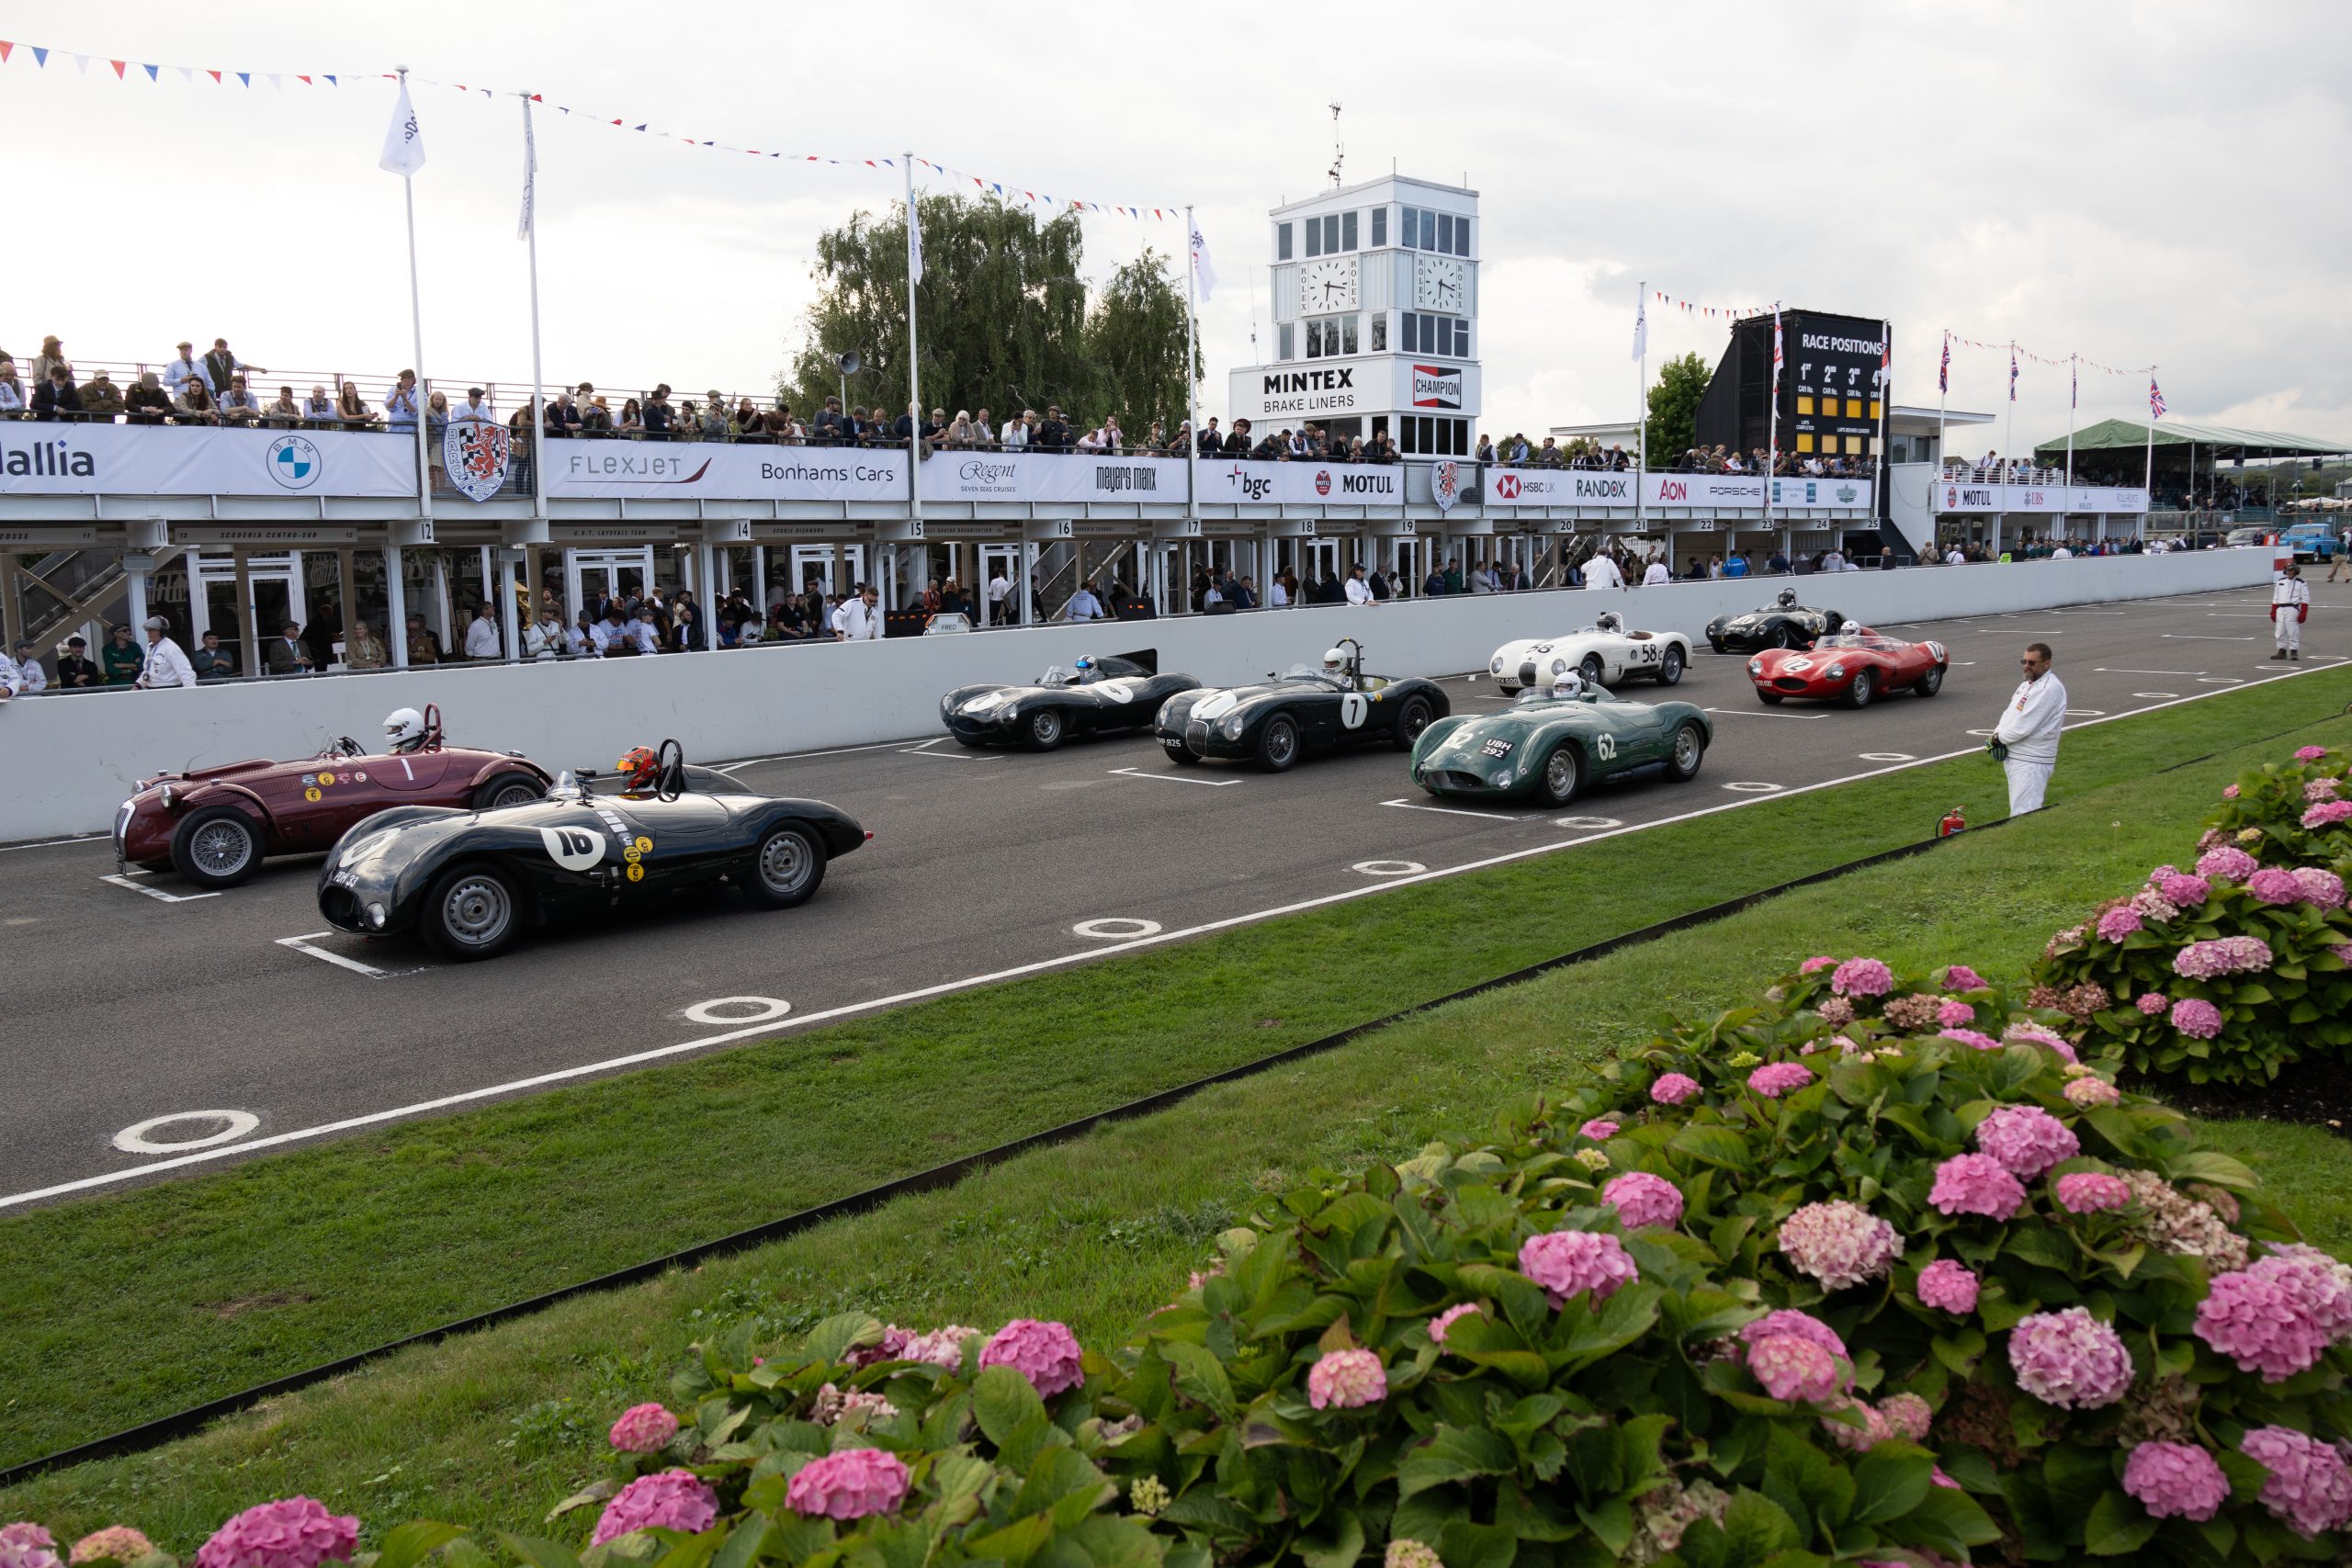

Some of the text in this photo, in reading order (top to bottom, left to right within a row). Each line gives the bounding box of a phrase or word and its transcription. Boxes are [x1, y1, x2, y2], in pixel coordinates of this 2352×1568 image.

[1803, 333, 1883, 355] RACE POSITIONS
[1264, 368, 1353, 395] MINTEX
[1415, 379, 1460, 396] CHAMPION
[1798, 385, 1806, 393] CAR
[1823, 387, 1831, 395] CAR
[1847, 389, 1856, 398] CAR
[1264, 395, 1354, 412] BRAKE LINERS
[274, 438, 313, 453] BMW
[0, 440, 95, 476] allia
[447, 428, 462, 479] BARC
[762, 463, 894, 481] Bonhams Cars
[960, 460, 1015, 483] Regent
[1242, 472, 1271, 500] bgc
[1342, 475, 1394, 493] MOTUL
[1523, 482, 1555, 493] HSBC UK
[1577, 479, 1626, 498] RANDOX
[1710, 486, 1761, 496] PORSCHE
[1962, 490, 1992, 506] MOTUL
[2031, 492, 2044, 506] UBS
[738, 523, 749, 537] 14
[910, 523, 922, 536] 15
[1058, 522, 1070, 535] 16
[1188, 521, 1198, 533] 17
[1302, 521, 1313, 533] 18
[1402, 521, 1413, 531] 19
[1560, 521, 1572, 531] 20
[1635, 521, 1645, 530] 21
[1701, 520, 1712, 529] 22
[1762, 520, 1772, 528] 23
[1816, 519, 1826, 528] 24
[1868, 519, 1878, 528] 25
[157, 524, 166, 542] 11
[421, 524, 431, 540] 12
[1642, 644, 1657, 662] 58
[1785, 660, 1808, 671] 12
[1351, 699, 1358, 724] 7
[1487, 739, 1512, 750] UBH
[1598, 734, 1617, 761] 62
[1482, 747, 1504, 758] 292
[557, 829, 594, 856] 16
[346, 875, 359, 887] 33
